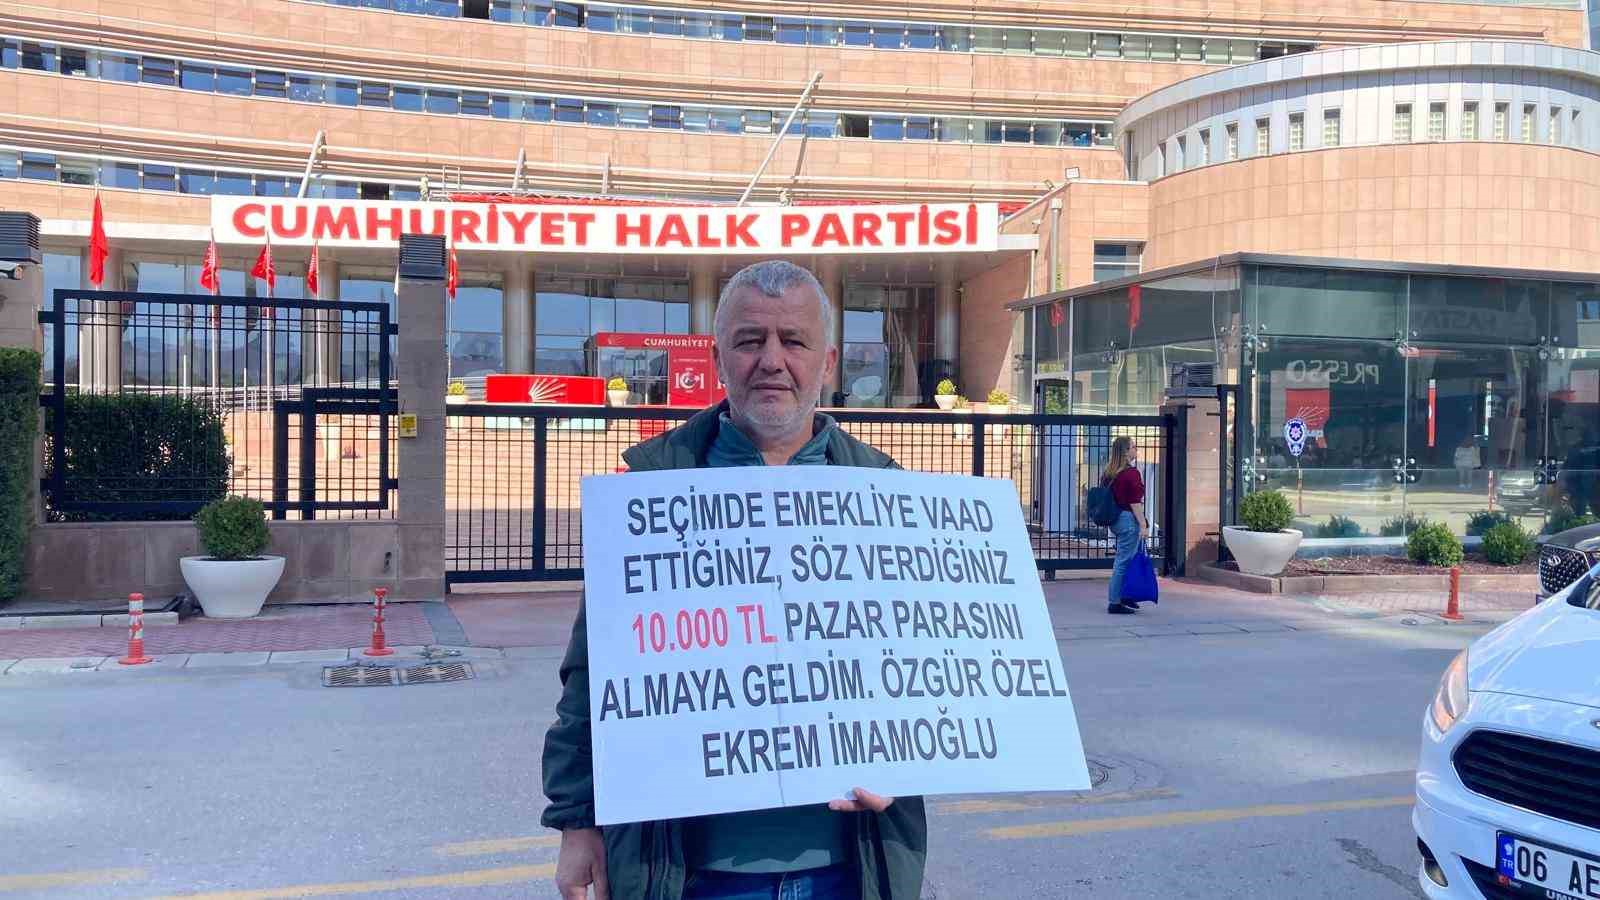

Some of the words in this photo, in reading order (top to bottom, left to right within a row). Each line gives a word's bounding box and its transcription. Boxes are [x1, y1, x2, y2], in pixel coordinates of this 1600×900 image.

[232, 203, 596, 246] CUMHURİYET
[615, 213, 760, 248] HALK
[780, 203, 978, 248] PARTİSİ
[644, 337, 708, 348] CUMHURİYET
[627, 486, 766, 542] SEÇİMDE
[773, 484, 918, 529] EMEKLİYE
[920, 495, 994, 533] VAAD
[623, 537, 783, 594] ETTİĞİNİZ,
[790, 535, 853, 583] SÖZ
[856, 537, 1016, 585] VERDİĞİNİZ
[632, 607, 729, 655] 10.000
[736, 604, 778, 645] TL
[784, 600, 889, 642] PAZAR
[892, 600, 1024, 641] PARASINI
[599, 668, 736, 722] ALMAYA
[742, 649, 875, 708] GELDİM.
[881, 648, 989, 699] ÖZGÜR
[991, 648, 1067, 698] ÖZEL
[702, 724, 822, 778] EKREM
[827, 703, 998, 766] İMAMOĞLU
[1502, 858, 1514, 870] TR
[1517, 846, 1548, 882] 06
